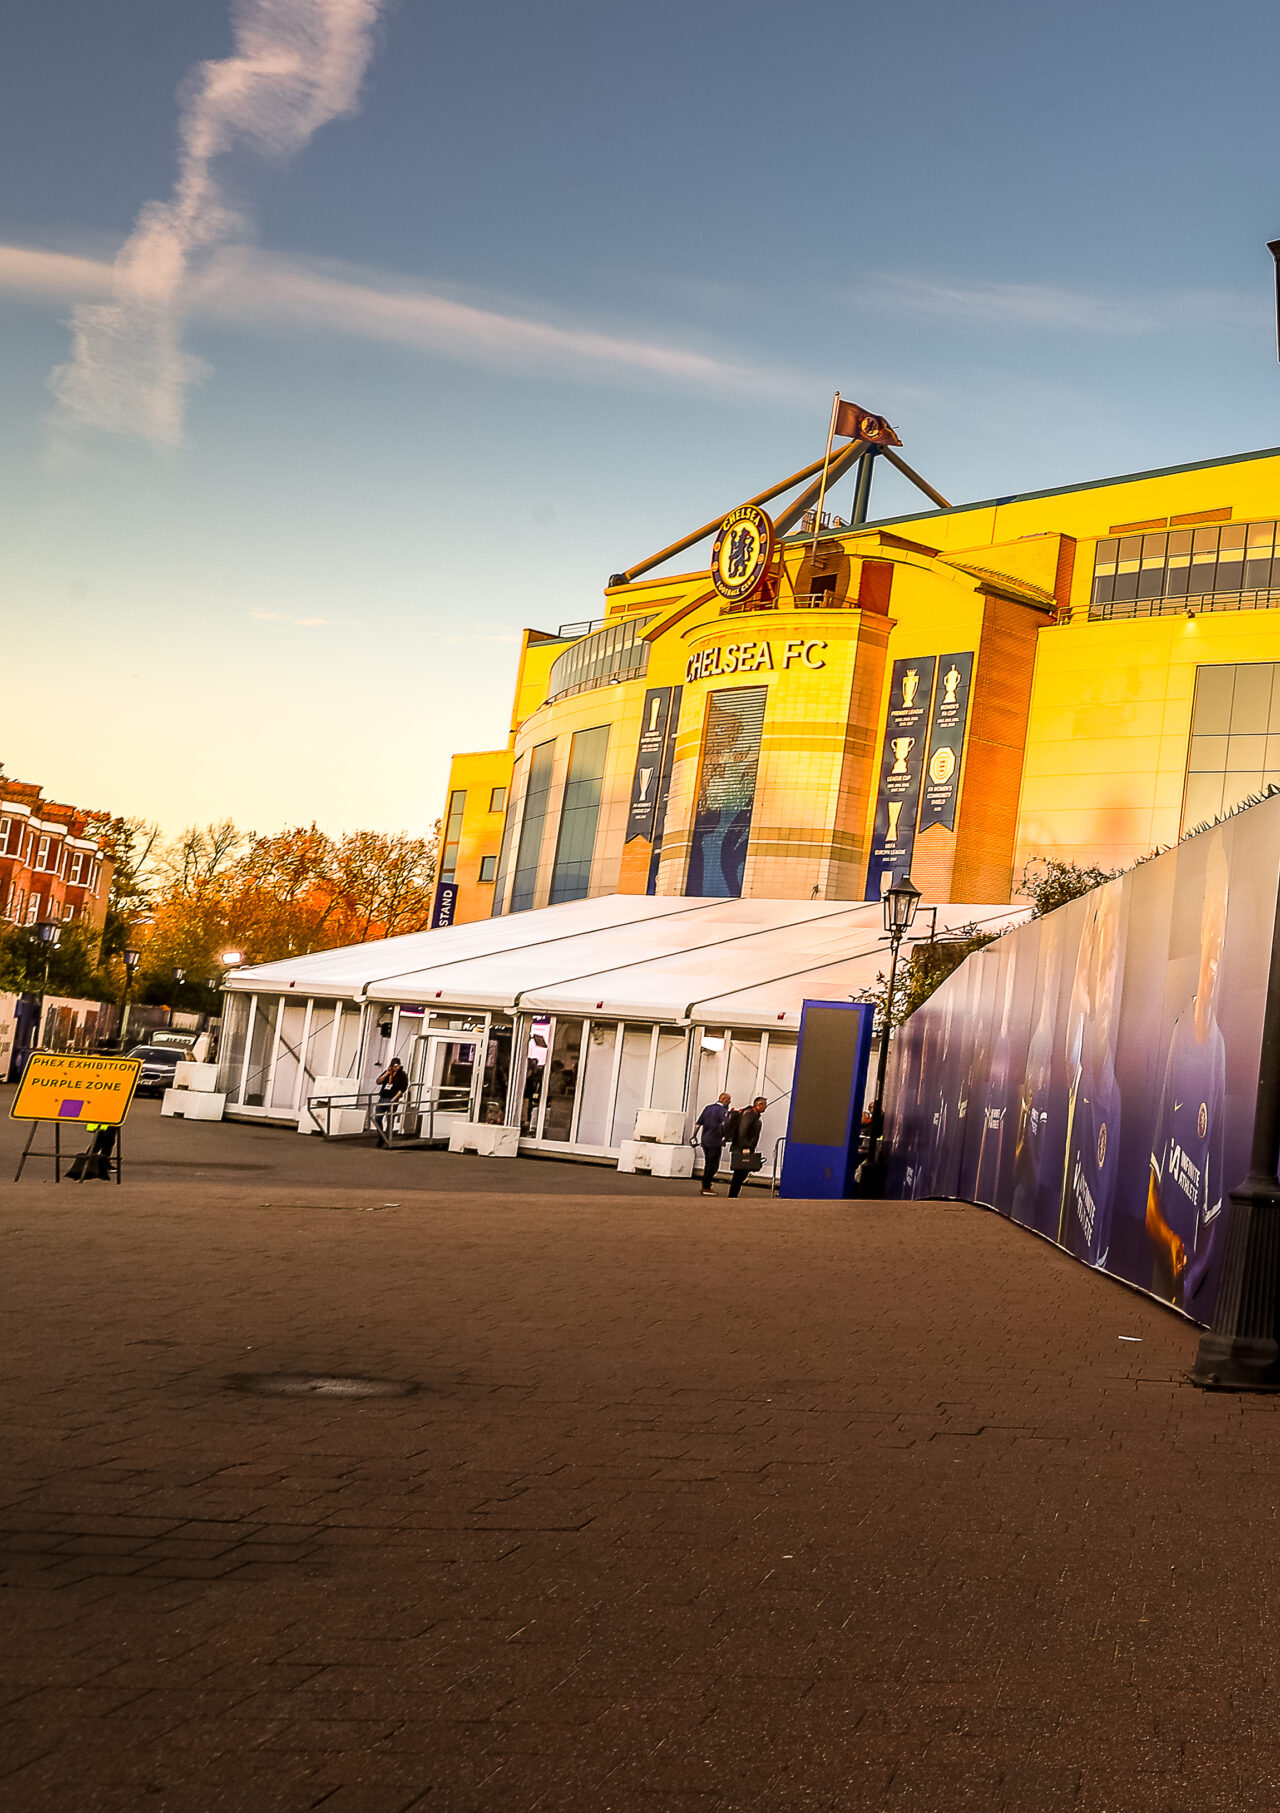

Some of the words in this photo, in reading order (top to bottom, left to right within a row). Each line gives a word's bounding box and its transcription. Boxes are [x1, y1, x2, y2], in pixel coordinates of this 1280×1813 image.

[723, 507, 760, 531] CHELSEA
[685, 640, 774, 683] CHELSEA
[782, 639, 828, 669] FC
[439, 889, 453, 927] STAND
[32, 1057, 65, 1068] PHEX
[67, 1060, 137, 1072] EXHIBITION
[31, 1077, 82, 1089] PURPLE
[85, 1081, 122, 1092] ZONE
